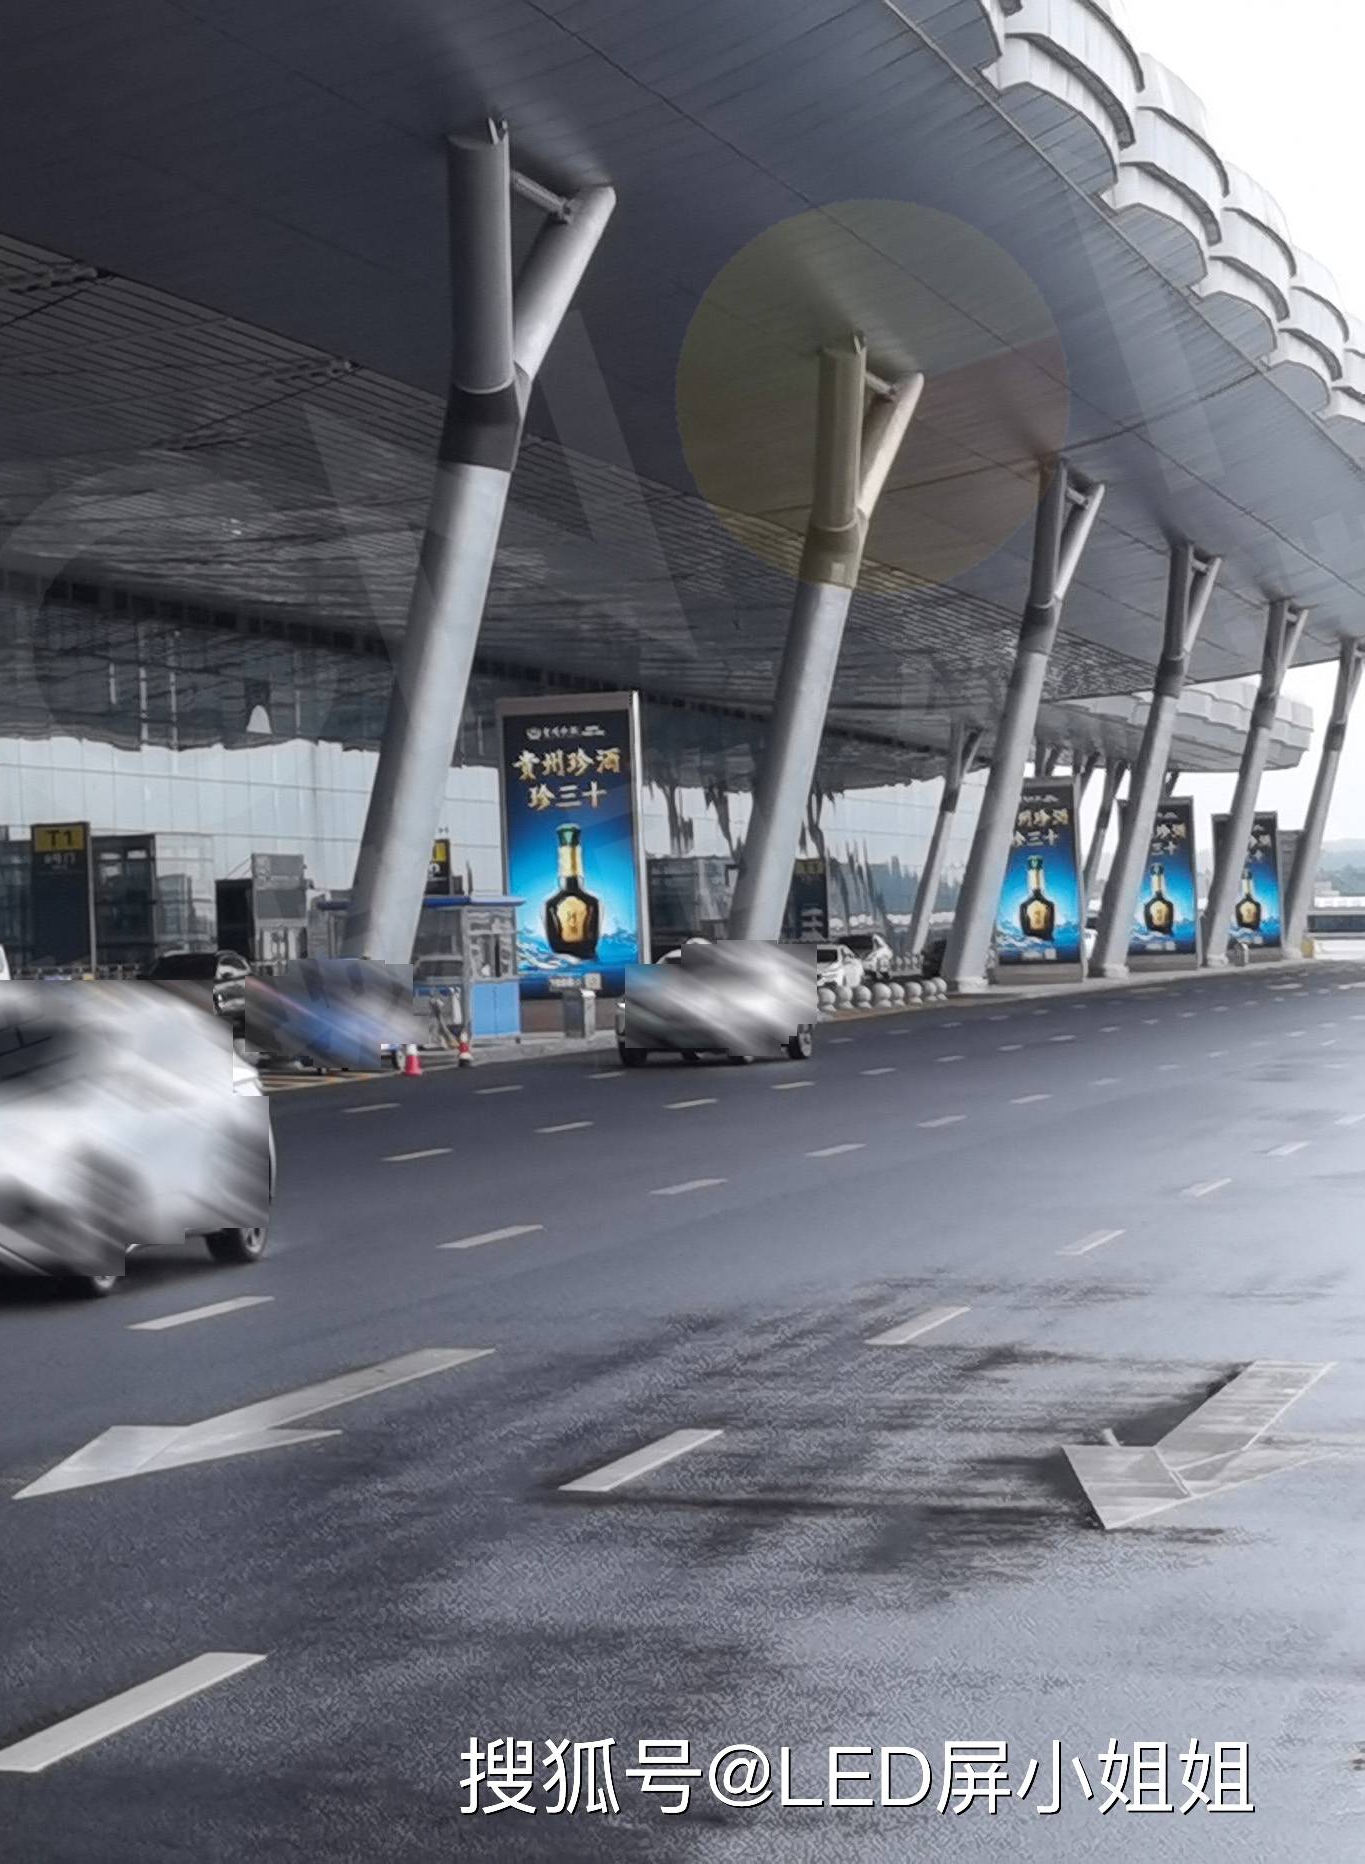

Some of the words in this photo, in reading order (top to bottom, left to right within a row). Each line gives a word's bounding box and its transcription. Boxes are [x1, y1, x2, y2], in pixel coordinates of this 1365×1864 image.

[512, 747, 621, 780] 贵州珍酒
[528, 781, 608, 811] 珍三十
[46, 830, 72, 847] T1
